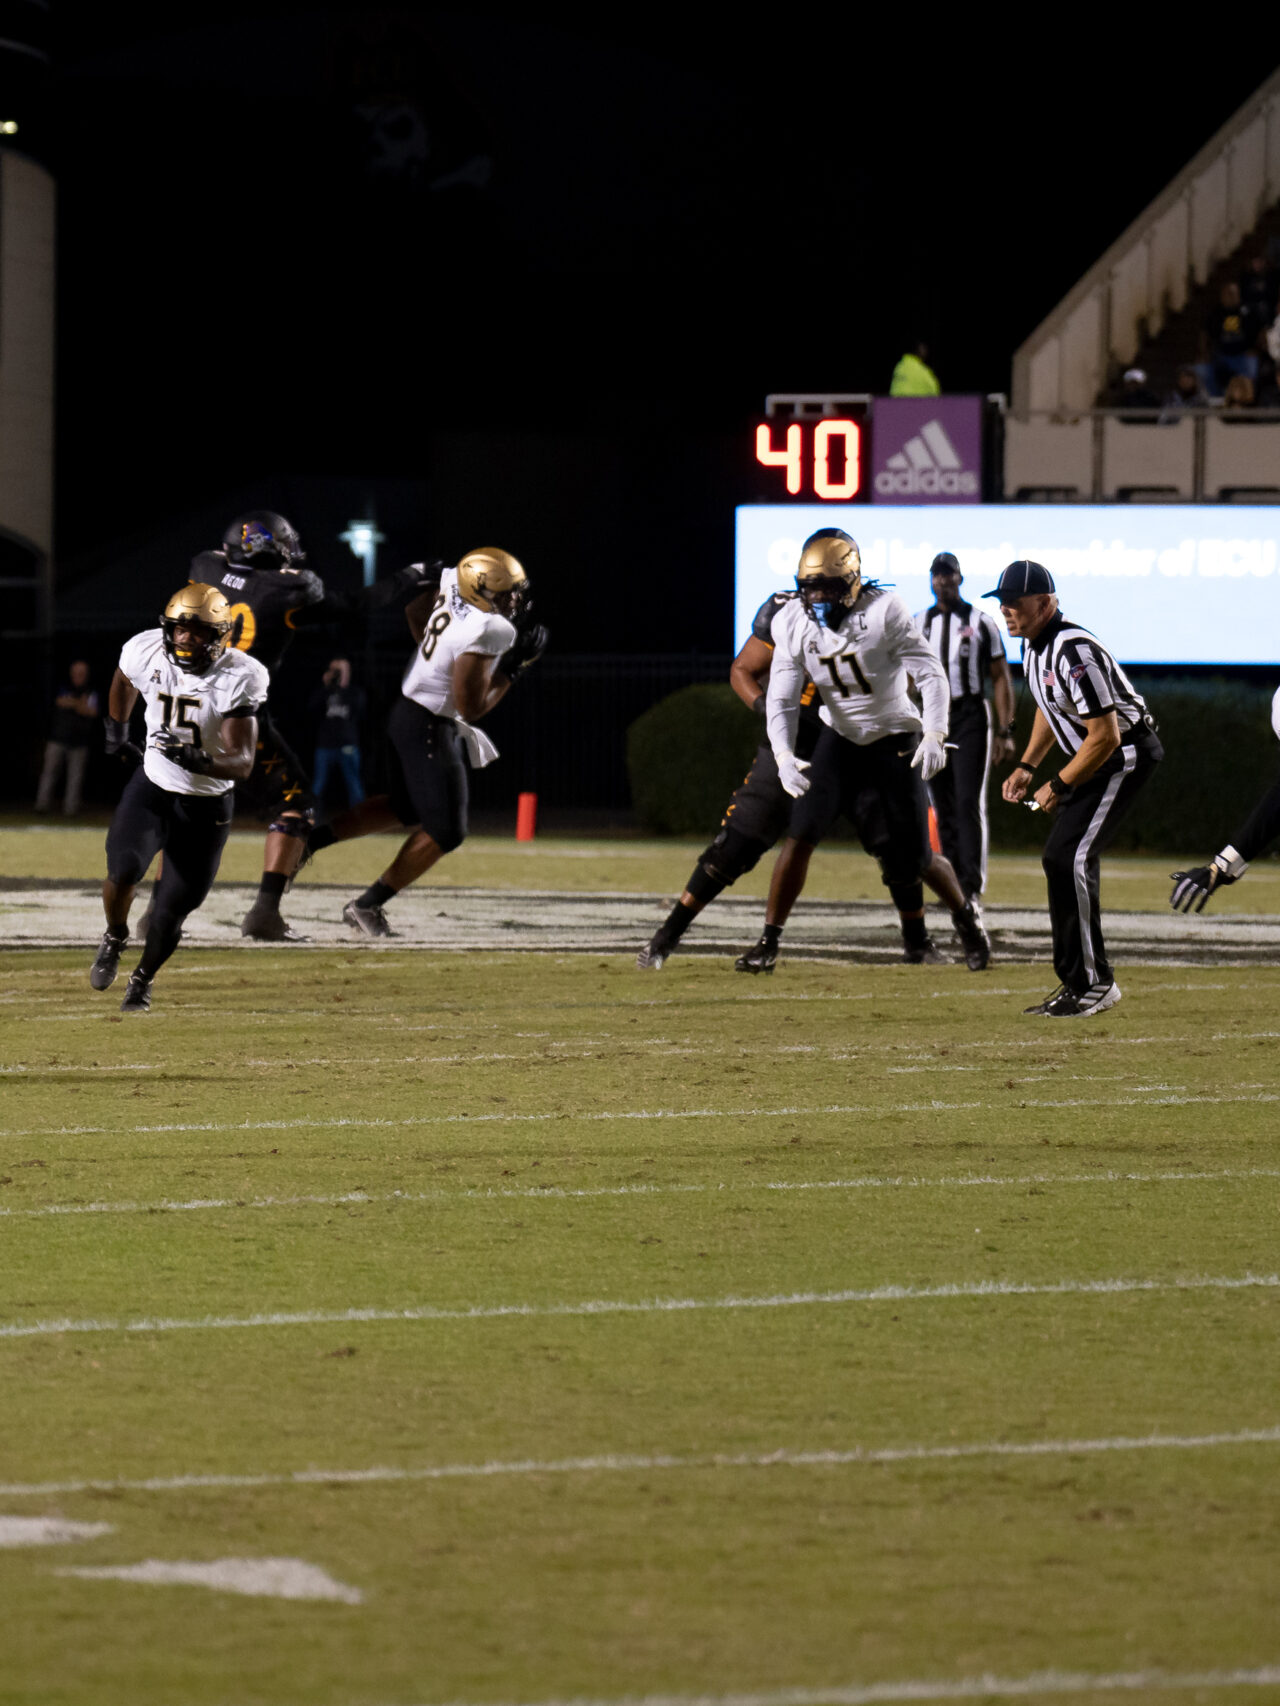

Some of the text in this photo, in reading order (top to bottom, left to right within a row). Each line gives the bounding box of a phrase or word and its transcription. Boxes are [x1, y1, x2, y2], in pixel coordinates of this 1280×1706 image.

[756, 419, 860, 499] 40
[874, 467, 978, 496] adidas
[819, 651, 873, 699] 11
[157, 691, 203, 749] 15
